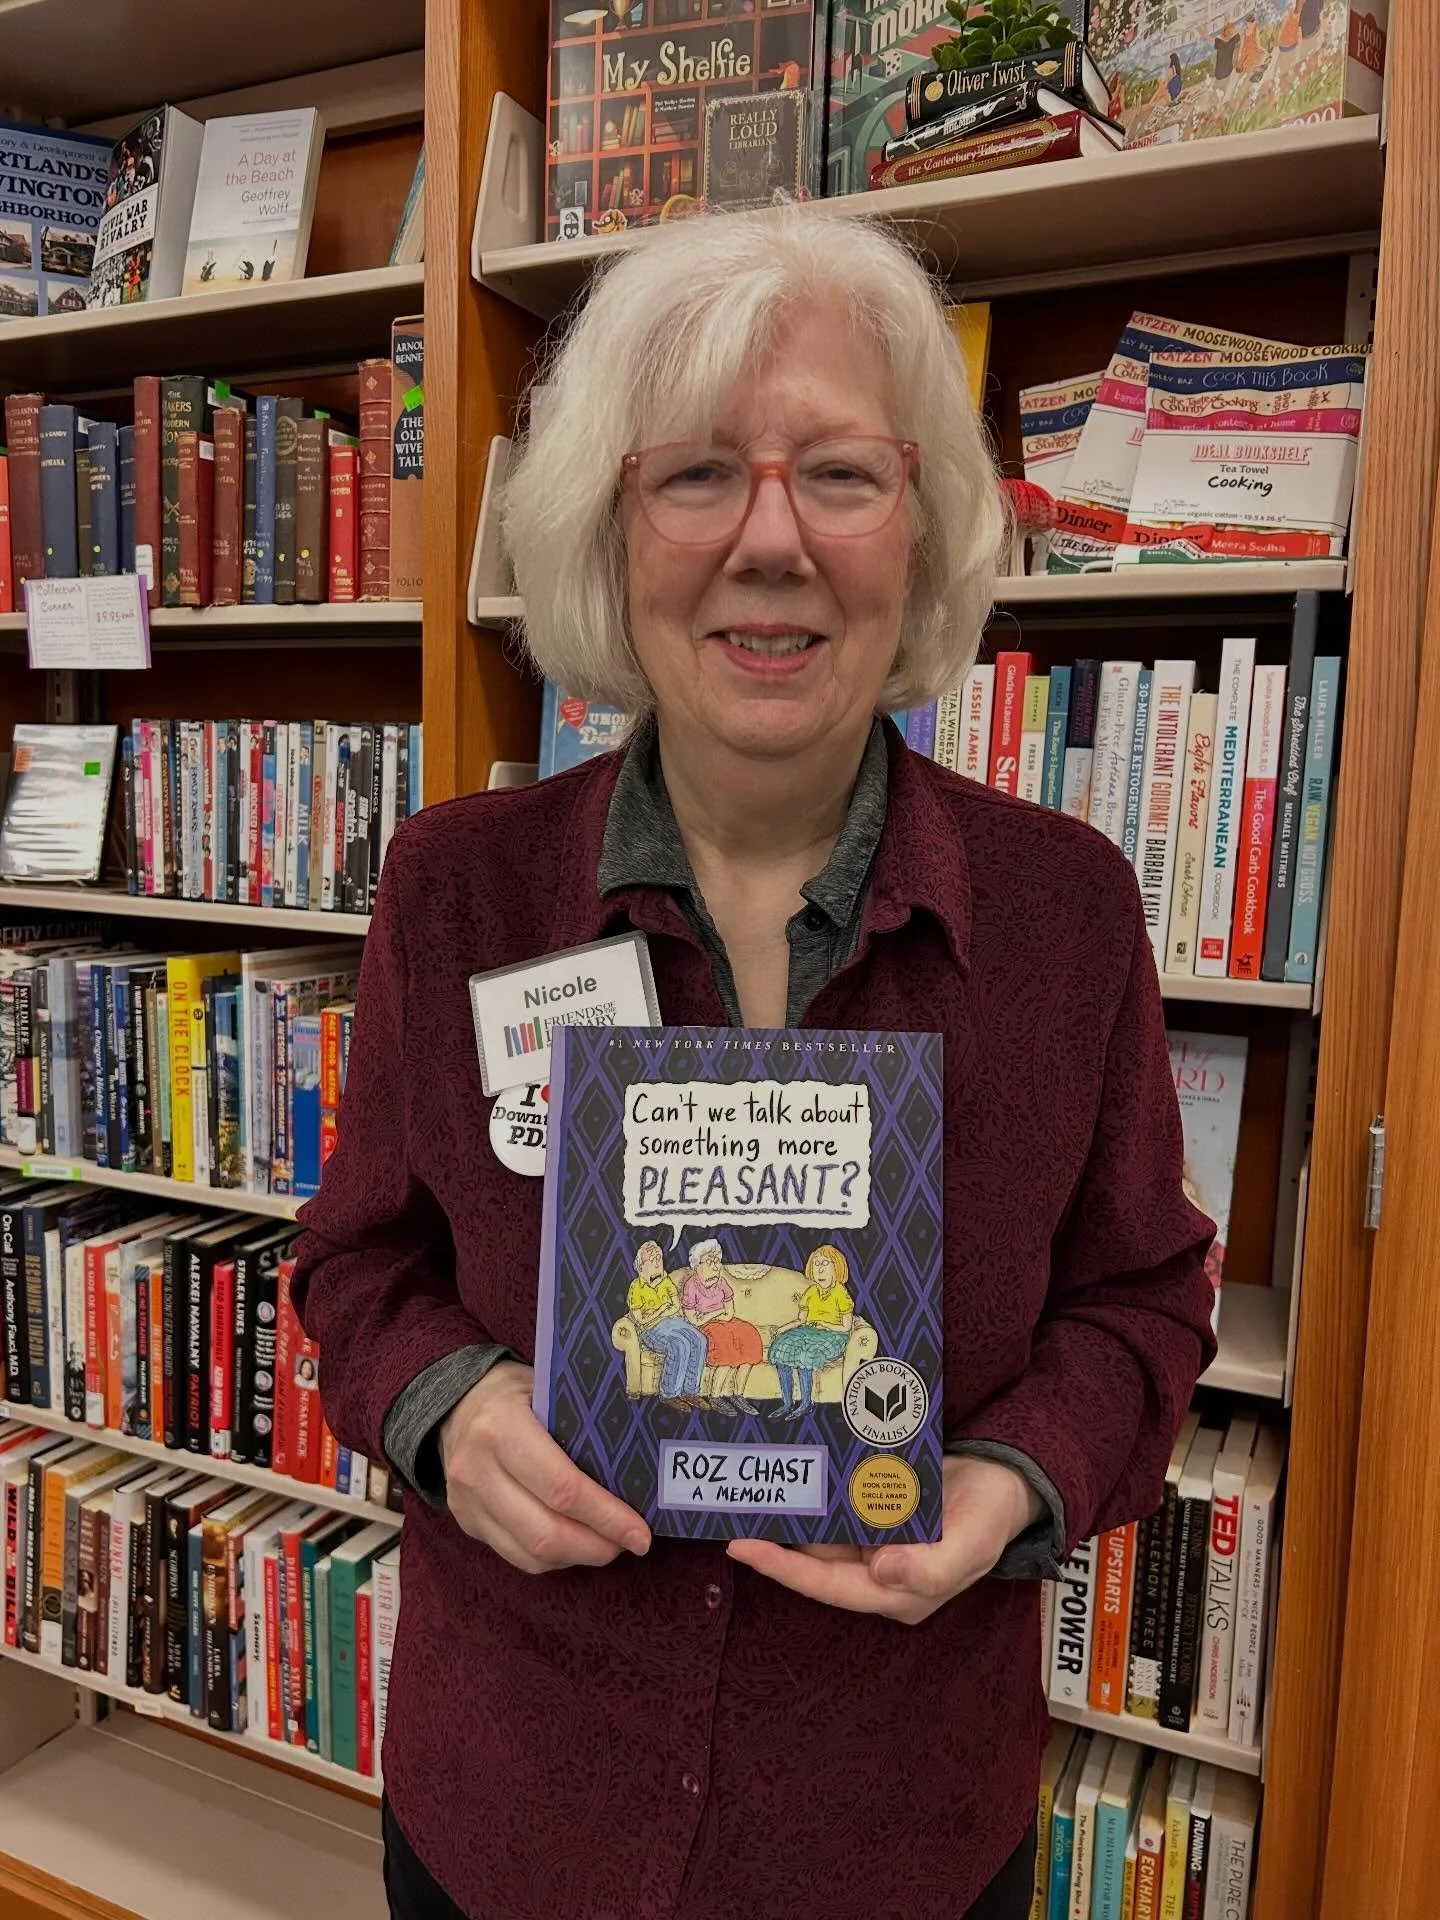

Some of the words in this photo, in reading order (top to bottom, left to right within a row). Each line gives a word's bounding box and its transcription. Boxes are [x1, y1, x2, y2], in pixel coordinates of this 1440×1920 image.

[1356, 20, 1382, 48] 1000
[602, 52, 650, 93] My
[657, 38, 750, 86] Shelfie
[1356, 45, 1381, 70] PCS
[947, 69, 989, 97] Oliver
[992, 59, 1027, 88] Twist
[729, 109, 778, 126] REALLY
[729, 122, 778, 141] LOUD
[251, 150, 279, 168] Day
[729, 137, 777, 150] LIBRARIANS
[225, 171, 248, 185] the
[251, 168, 294, 183] Beach
[241, 188, 290, 204] Geoffrey
[257, 201, 290, 218] Wolff
[100, 215, 146, 250] RIVALRY
[102, 212, 124, 236] CIVIL
[126, 200, 148, 219] WAR
[1156, 352, 1213, 364] KATZEN
[1219, 348, 1308, 364] MOOSEWOOD
[1202, 370, 1246, 388] COOK
[1282, 362, 1328, 386] BOOK
[401, 417, 424, 429] THE
[401, 430, 424, 442] OLD
[1220, 464, 1237, 474] Tea
[1239, 464, 1269, 474] Towel
[1234, 444, 1312, 462] BOOKSHELF
[1207, 475, 1273, 497] Cooking
[1186, 511, 1213, 519] organic
[1211, 539, 1247, 550] Meera
[1249, 541, 1286, 553] Sodha
[1006, 665, 1016, 691] Giada
[1232, 658, 1242, 675] THE
[971, 680, 983, 721] JESSIE
[1006, 693, 1014, 705] De
[1113, 677, 1129, 747] Gluten-Free
[1160, 685, 1182, 705] THE
[1229, 676, 1241, 721] COMPLETE
[1293, 696, 1307, 717] The
[1316, 680, 1329, 717] LAURA
[1053, 720, 1061, 735] The
[1133, 683, 1149, 751] 30-MINUTE
[946, 719, 956, 755] WINES
[967, 728, 980, 771] JAMES
[1050, 737, 1060, 756] Easy
[1153, 710, 1179, 778] INTOLERANT
[1188, 733, 1211, 774] Eight
[1287, 718, 1304, 768] Shredded
[1313, 720, 1326, 760] MILLER
[1028, 744, 1036, 770] FRESH
[1094, 735, 1108, 783] Minutes
[1108, 751, 1126, 798] Artisan
[1126, 755, 1142, 825] KETOGENIC
[1188, 780, 1205, 830] Flavors
[1213, 725, 1238, 868] MEDITERRANEAN
[1253, 789, 1267, 811] The
[297, 804, 307, 845] MILK
[336, 800, 344, 831] SAFE
[346, 790, 358, 843] snatch
[1104, 801, 1118, 835] Bread
[1147, 782, 1172, 835] GOURMET
[1282, 802, 1293, 839] MICHAEL
[1305, 804, 1321, 842] VEGAN.
[1251, 814, 1265, 844] Good
[335, 832, 343, 872] HOUSE
[1142, 838, 1166, 888] BARBARA
[1249, 848, 1262, 878] Carb
[1277, 841, 1289, 888] MATTHEWS
[1302, 844, 1317, 867] NOT
[1211, 872, 1222, 920] COOKBOOK
[1243, 880, 1260, 935] Cookbook
[173, 981, 188, 1002] ON
[524, 975, 598, 1009] Nicole
[20, 987, 30, 1045] WILDLIFE
[174, 1009, 188, 1037] THE
[328, 1014, 336, 1037] FAST
[544, 1005, 604, 1029] FRIENDS
[328, 1041, 336, 1066] FOOD
[609, 1039, 624, 1049] #1
[632, 1039, 666, 1049] NEW
[674, 1039, 715, 1049] YORK
[724, 1040, 772, 1050] TIMES
[782, 1041, 896, 1054] BESTSELLER
[175, 1045, 190, 1096] CLOCK
[328, 1069, 336, 1104] NATION
[520, 1082, 540, 1107] I
[632, 1090, 698, 1124] Can't
[708, 1104, 737, 1123] we
[743, 1090, 792, 1125] talk
[801, 1091, 864, 1125] about
[639, 1126, 761, 1161] something
[778, 1138, 838, 1156] more
[638, 1160, 861, 1208] PLEASANT?
[2, 1214, 11, 1231] On
[4, 1232, 13, 1253] Call
[25, 1254, 42, 1315] BECOMING
[190, 1254, 200, 1302] ALEXEI
[236, 1259, 246, 1300] STOLEN
[5, 1279, 17, 1324] Anthony
[236, 1302, 245, 1335] LIVES
[27, 1318, 44, 1367] LINCOLN
[190, 1305, 200, 1368] NAVALNY
[10, 1355, 19, 1376] M.D.
[190, 1373, 199, 1429] PATRIOT
[299, 1390, 310, 1427] SUSAN
[848, 1364, 878, 1416] NATIONAL
[878, 1363, 907, 1381] BOOK
[902, 1375, 925, 1419] AWARD
[298, 1429, 308, 1458] RICE
[861, 1424, 910, 1441] FINALIST
[672, 1450, 728, 1482] ROZ
[738, 1455, 815, 1484] CHAST
[869, 1471, 901, 1479] NATIONAL
[692, 1485, 703, 1500] A
[716, 1486, 786, 1502] MEMOIR
[867, 1503, 902, 1511] WINNER
[7, 1487, 17, 1540] WILD
[1212, 1495, 1239, 1557] TED
[26, 1530, 34, 1558] MADE
[1256, 1519, 1264, 1545] GOOD
[110, 1520, 124, 1581] IMMINENT
[25, 1559, 34, 1607] AMERICA
[169, 1549, 179, 1599] SCORPIONS
[287, 1557, 297, 1604] DIFFER
[1104, 1536, 1125, 1614] UPSTARTS
[1146, 1539, 1161, 1598] LEMON
[1177, 1571, 1185, 1596] WORLD
[1252, 1549, 1262, 1588] MANNERS
[6, 1575, 16, 1623] BILL
[207, 1564, 216, 1625] UNBROKEN
[378, 1572, 392, 1610] ALTER
[1206, 1558, 1233, 1631] TALKS
[1057, 1579, 1088, 1674] POWER
[1250, 1600, 1259, 1620] NICE
[378, 1615, 392, 1647] EGOS
[1143, 1607, 1156, 1650] TREE
[1248, 1623, 1257, 1655] PEOPLE
[1211, 1636, 1220, 1660] CHRIS
[379, 1657, 391, 1691] MARK
[1208, 1660, 1219, 1700] ANDERSON
[1077, 1829, 1085, 1862] Principles
[1191, 1820, 1205, 1871] RUNNING
[1230, 1840, 1246, 1868] THE
[1138, 1856, 1155, 1920] ECKHART
[1227, 1869, 1242, 1907] PURE
